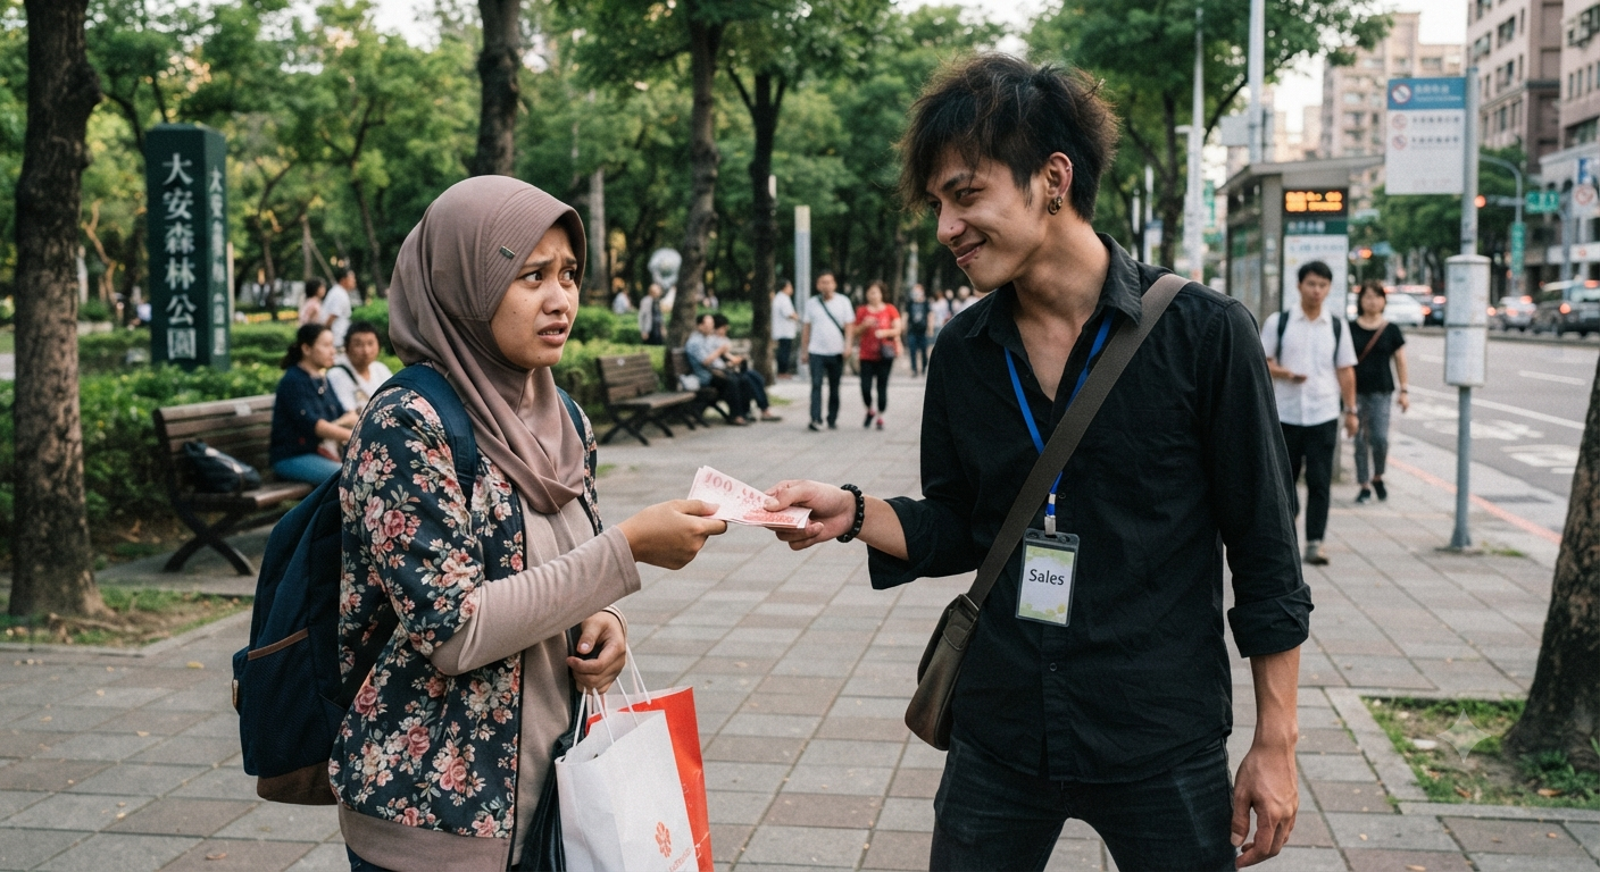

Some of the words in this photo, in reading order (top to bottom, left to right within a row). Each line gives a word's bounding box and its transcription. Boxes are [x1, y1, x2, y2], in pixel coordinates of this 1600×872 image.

[162, 152, 197, 360] 大安森林公園
[1028, 568, 1065, 586] Sales
